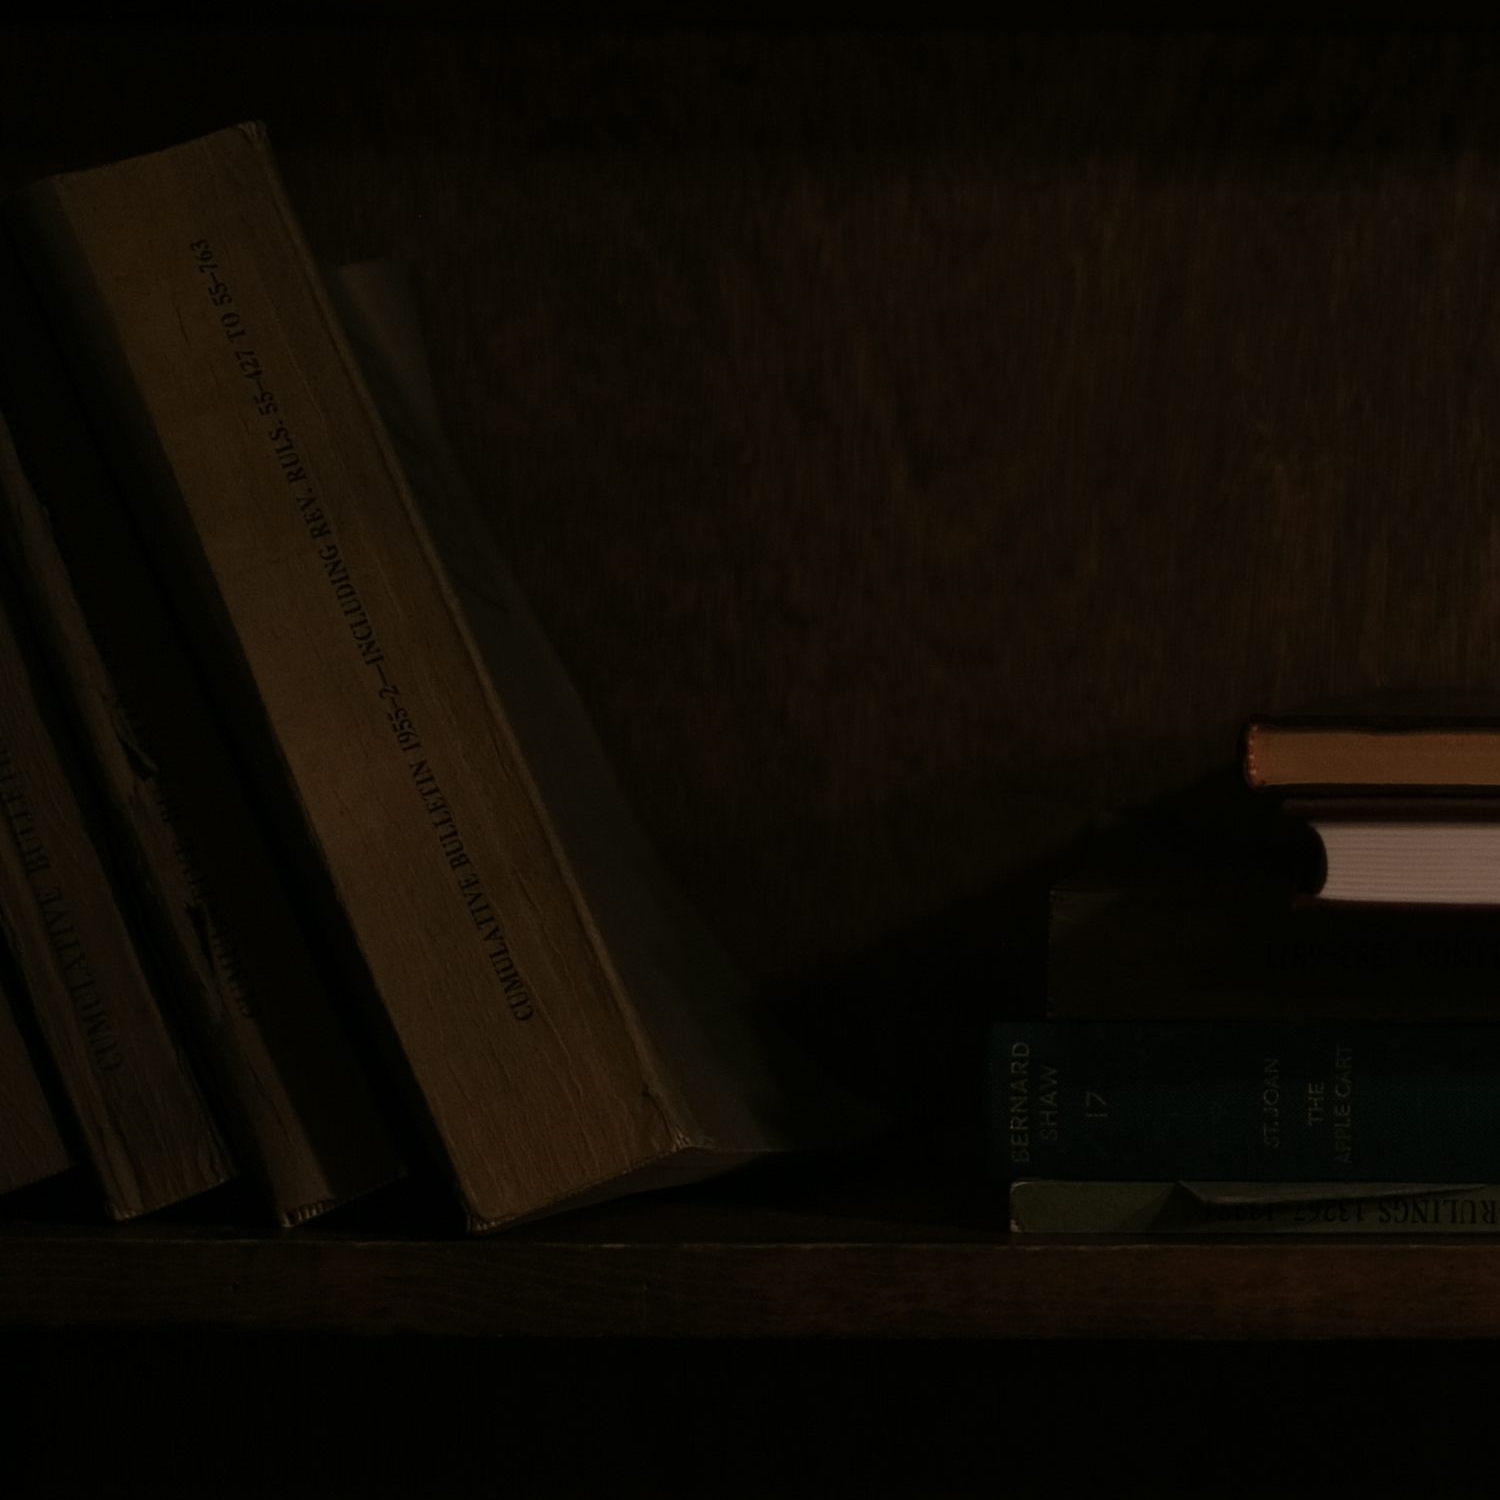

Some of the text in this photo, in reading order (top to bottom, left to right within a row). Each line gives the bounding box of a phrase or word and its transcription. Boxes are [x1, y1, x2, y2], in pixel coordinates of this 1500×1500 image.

[220, 313, 246, 340] TO
[269, 422, 310, 481] RULS.
[297, 488, 331, 538] REV.
[408, 759, 473, 869] BULLETIN
[36, 885, 123, 1073] CUMULATIVE
[457, 873, 536, 1022] CUMULATIVE
[1009, 1041, 1031, 1164] BERNARD
[1039, 1063, 1059, 1142] SHAW
[1084, 1090, 1108, 1120] 17
[1306, 1081, 1325, 1126] THE
[1333, 1044, 1353, 1164] APPLE CART
